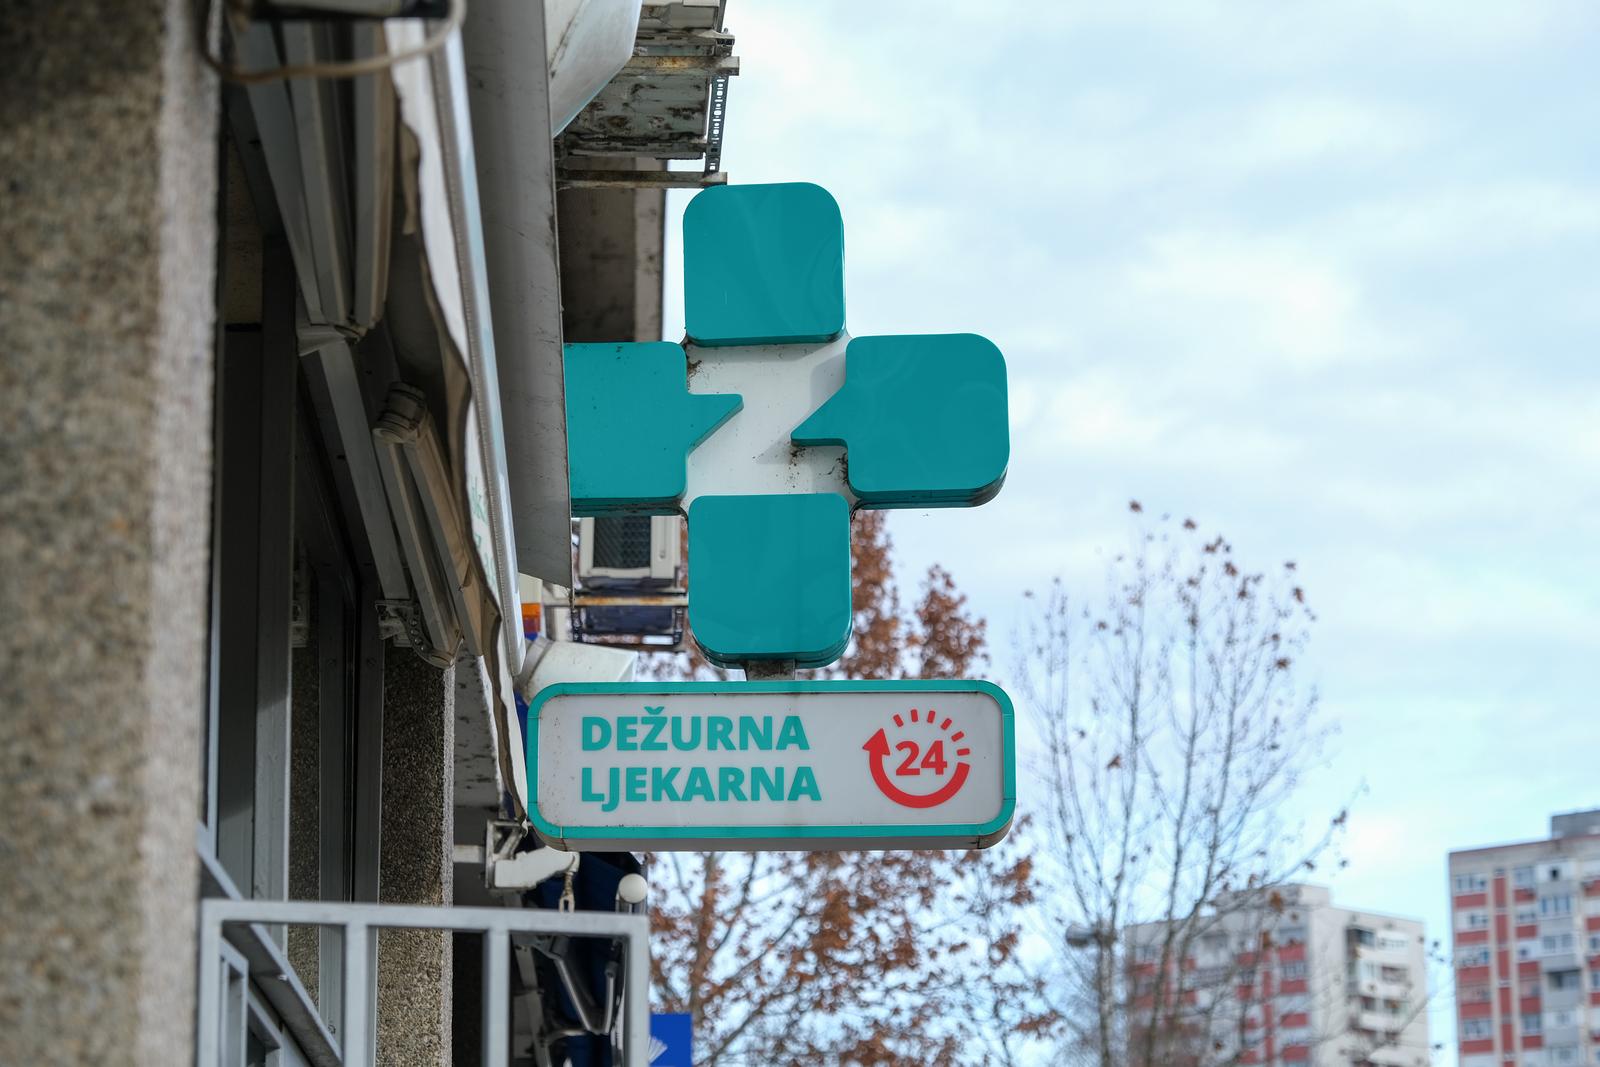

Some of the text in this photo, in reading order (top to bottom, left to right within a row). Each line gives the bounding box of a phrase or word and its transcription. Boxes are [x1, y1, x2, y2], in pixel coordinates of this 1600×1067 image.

[581, 706, 810, 751] DEŽURNA
[895, 740, 948, 776] 24
[581, 766, 822, 812] LJEKARNA
